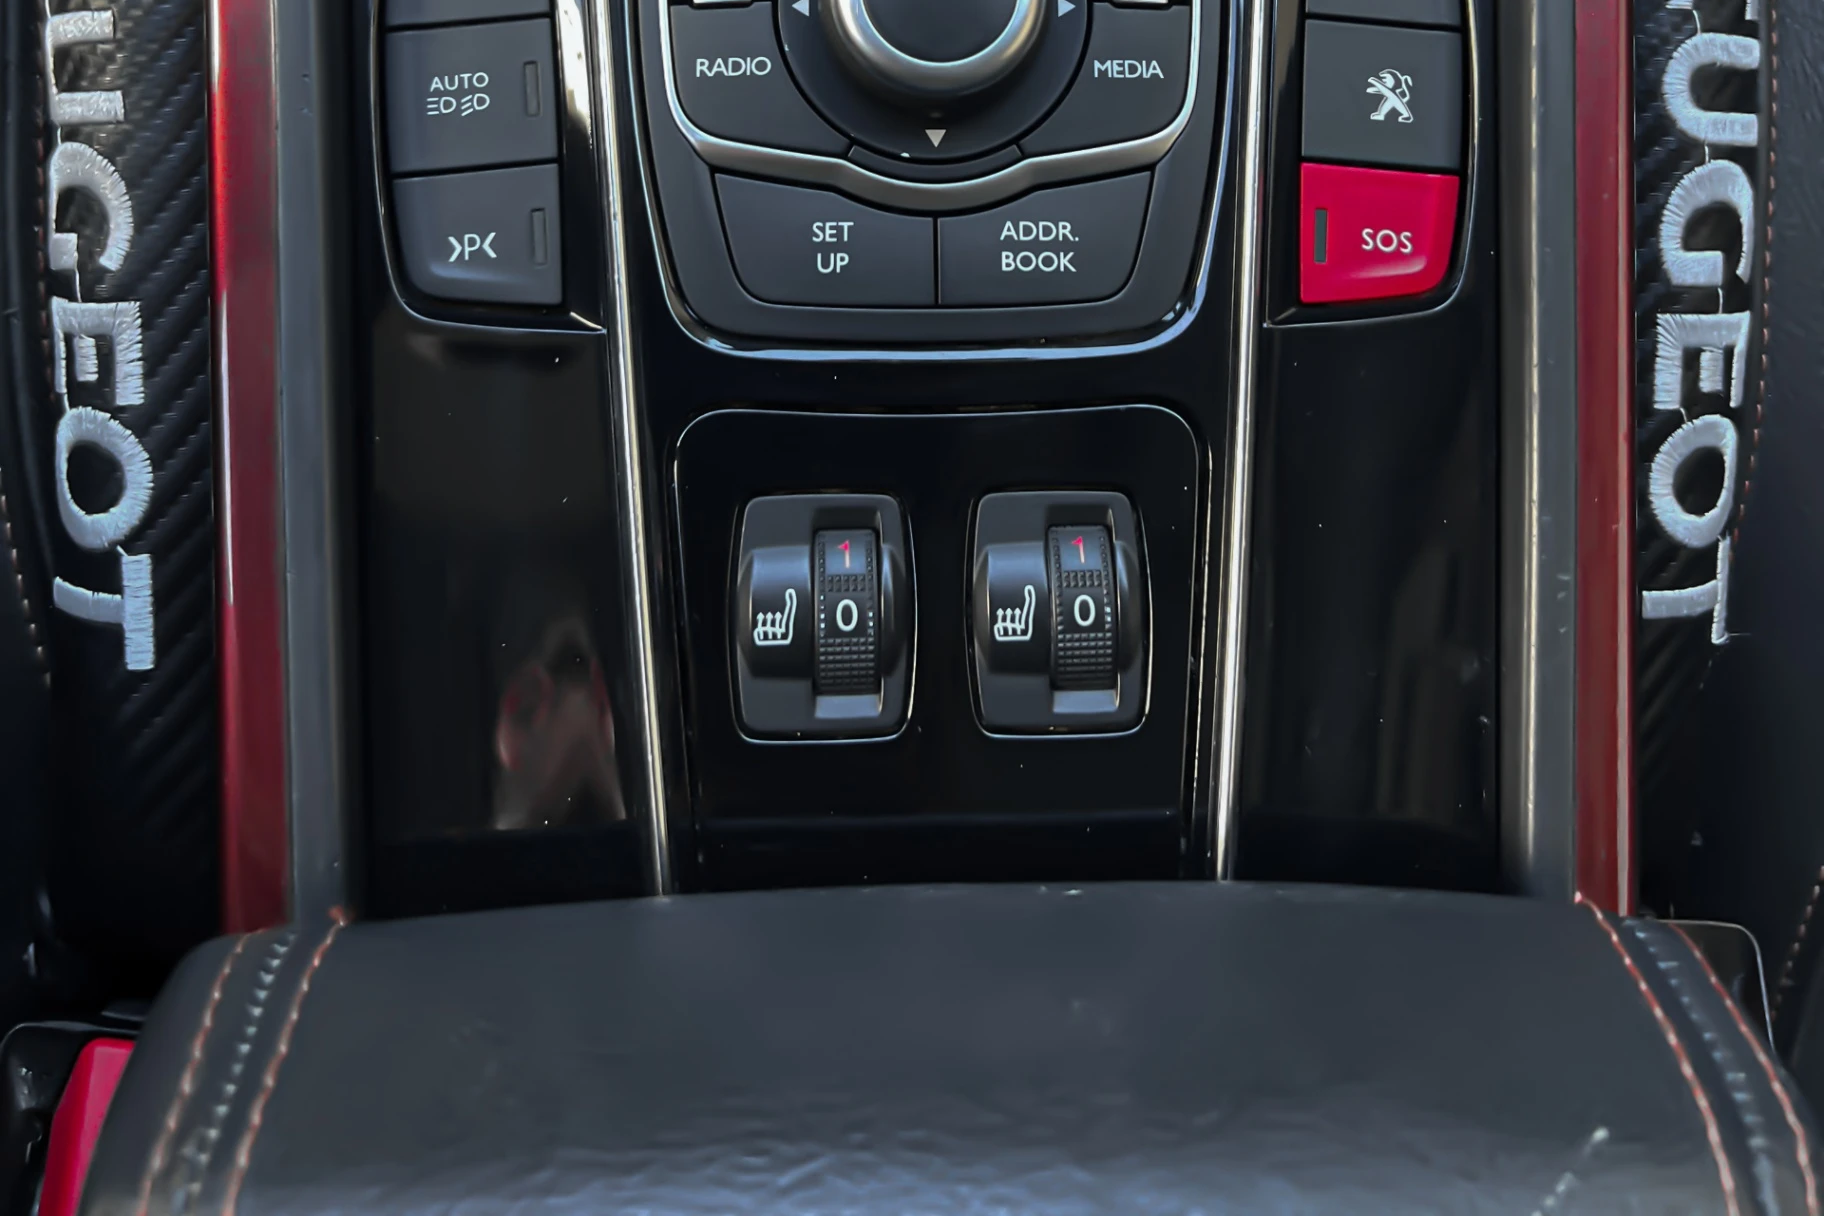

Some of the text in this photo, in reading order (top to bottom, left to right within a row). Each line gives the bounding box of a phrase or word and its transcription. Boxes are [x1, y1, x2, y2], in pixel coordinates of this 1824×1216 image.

[695, 56, 772, 78] RADIO
[1092, 58, 1165, 80] MEDIA
[429, 71, 490, 92] AUTO
[811, 221, 854, 243] SET
[999, 219, 1080, 243] ADDR.
[1361, 227, 1413, 255] SOS
[816, 252, 850, 275] UP
[1000, 251, 1077, 274] BOOK
[837, 540, 852, 569] 1
[1071, 536, 1086, 564] 1
[835, 598, 859, 632] 0
[1073, 594, 1097, 628] 0
